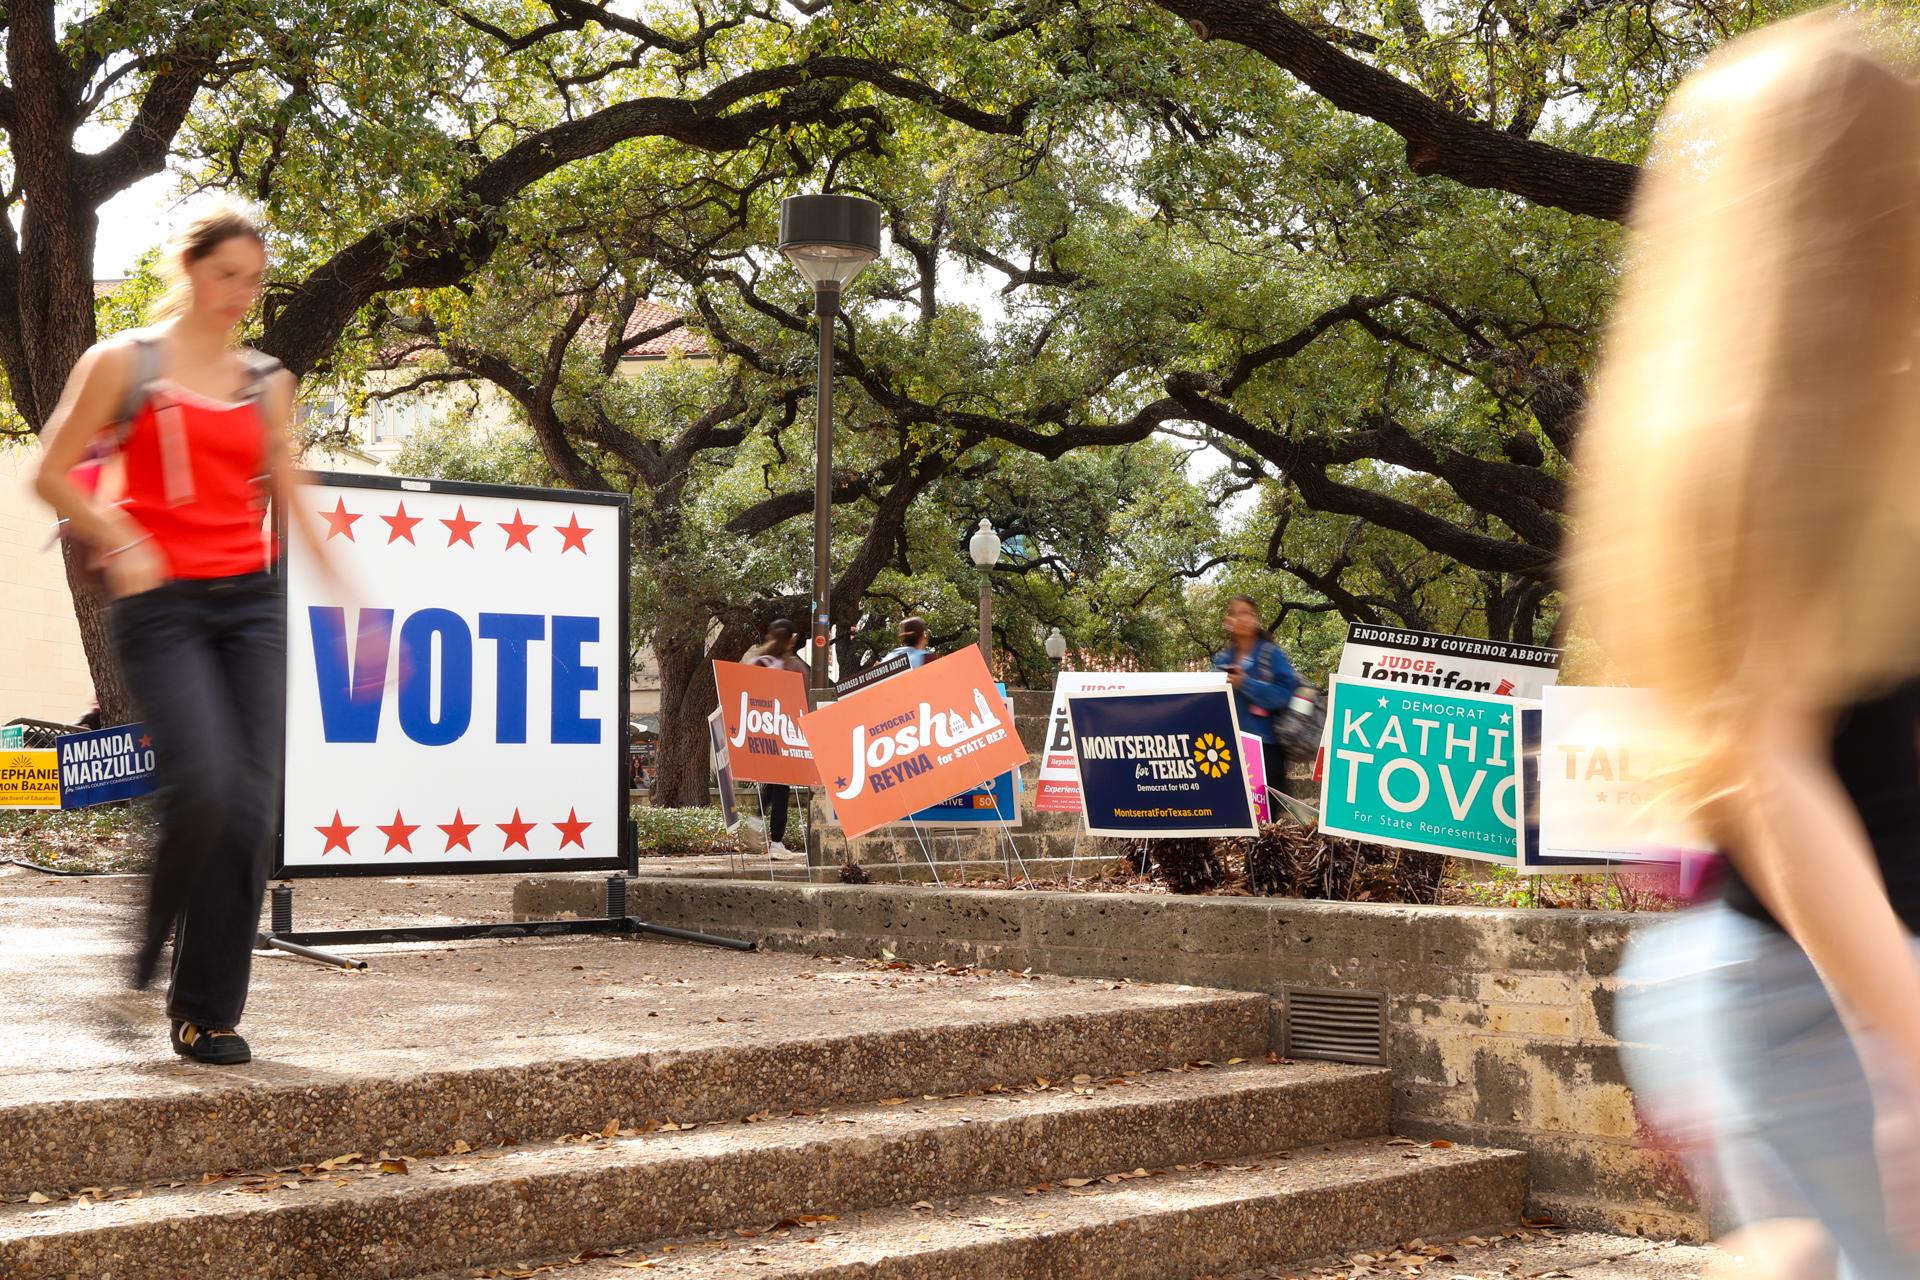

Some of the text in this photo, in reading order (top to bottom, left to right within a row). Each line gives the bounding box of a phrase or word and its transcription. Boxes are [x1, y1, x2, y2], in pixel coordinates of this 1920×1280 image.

[1353, 628, 1559, 664] ENDORSED BY GOVERNOR ABBOTT
[308, 606, 601, 746] VOTE
[836, 657, 908, 693] ENDORSED BY GOVERNOR ABBOTT
[1377, 655, 1436, 673] JUDGE
[730, 691, 789, 748] Josh
[868, 710, 916, 737] DEMOCRAT
[1401, 699, 1485, 720] DEMOCRAT
[62, 733, 134, 764] AMANDA
[747, 737, 780, 756] REYNA
[835, 702, 952, 800] Josh
[1081, 734, 1190, 759] MONTSERRAT
[1342, 709, 1510, 768] KATHI
[0, 768, 59, 780] EPHANIE
[62, 750, 156, 787] MARZULLO
[868, 728, 1008, 794] REYNA for STATE REP.
[1135, 759, 1197, 780] for TEXAS
[1557, 745, 1645, 782] TAL
[22, 780, 59, 791] BAZAN
[1137, 783, 1168, 792] Democrat
[1168, 783, 1178, 791] for
[1179, 783, 1189, 791] HD
[938, 798, 964, 806] ATIVE
[1114, 807, 1212, 817] MontserratForTexas.com
[1354, 811, 1517, 846] For State Representative
